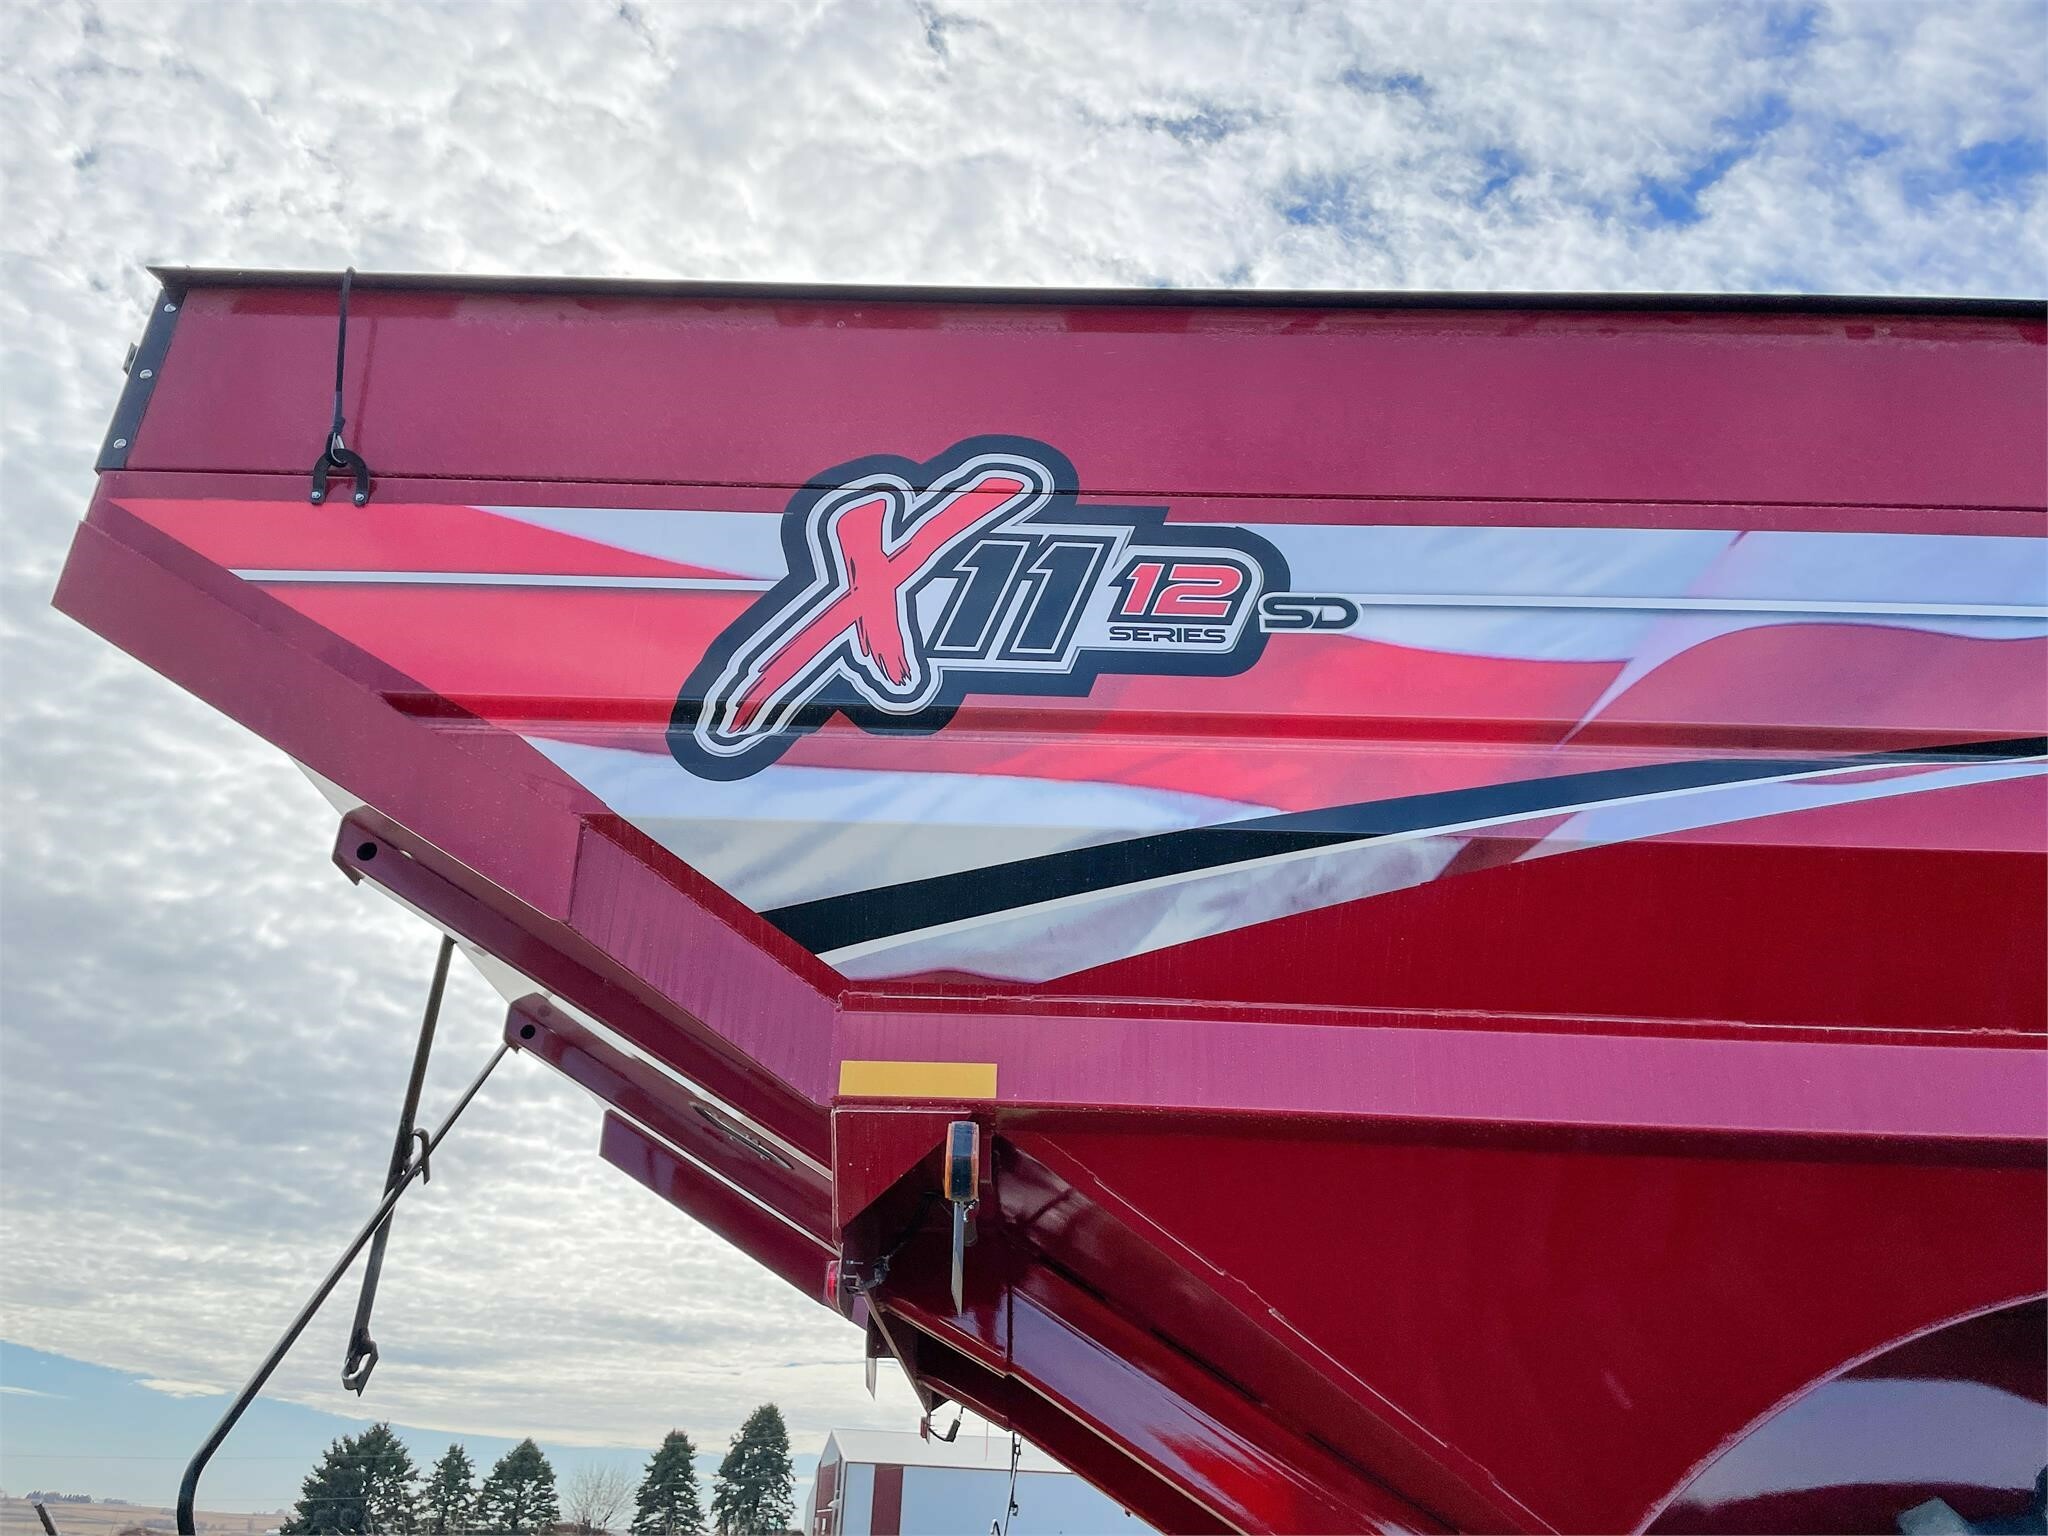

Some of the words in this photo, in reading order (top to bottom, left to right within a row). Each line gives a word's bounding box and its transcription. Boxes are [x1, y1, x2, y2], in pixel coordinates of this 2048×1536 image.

[1119, 561, 1245, 618] 12
[1263, 595, 1359, 630] SD
[1108, 625, 1227, 645] SERIES
